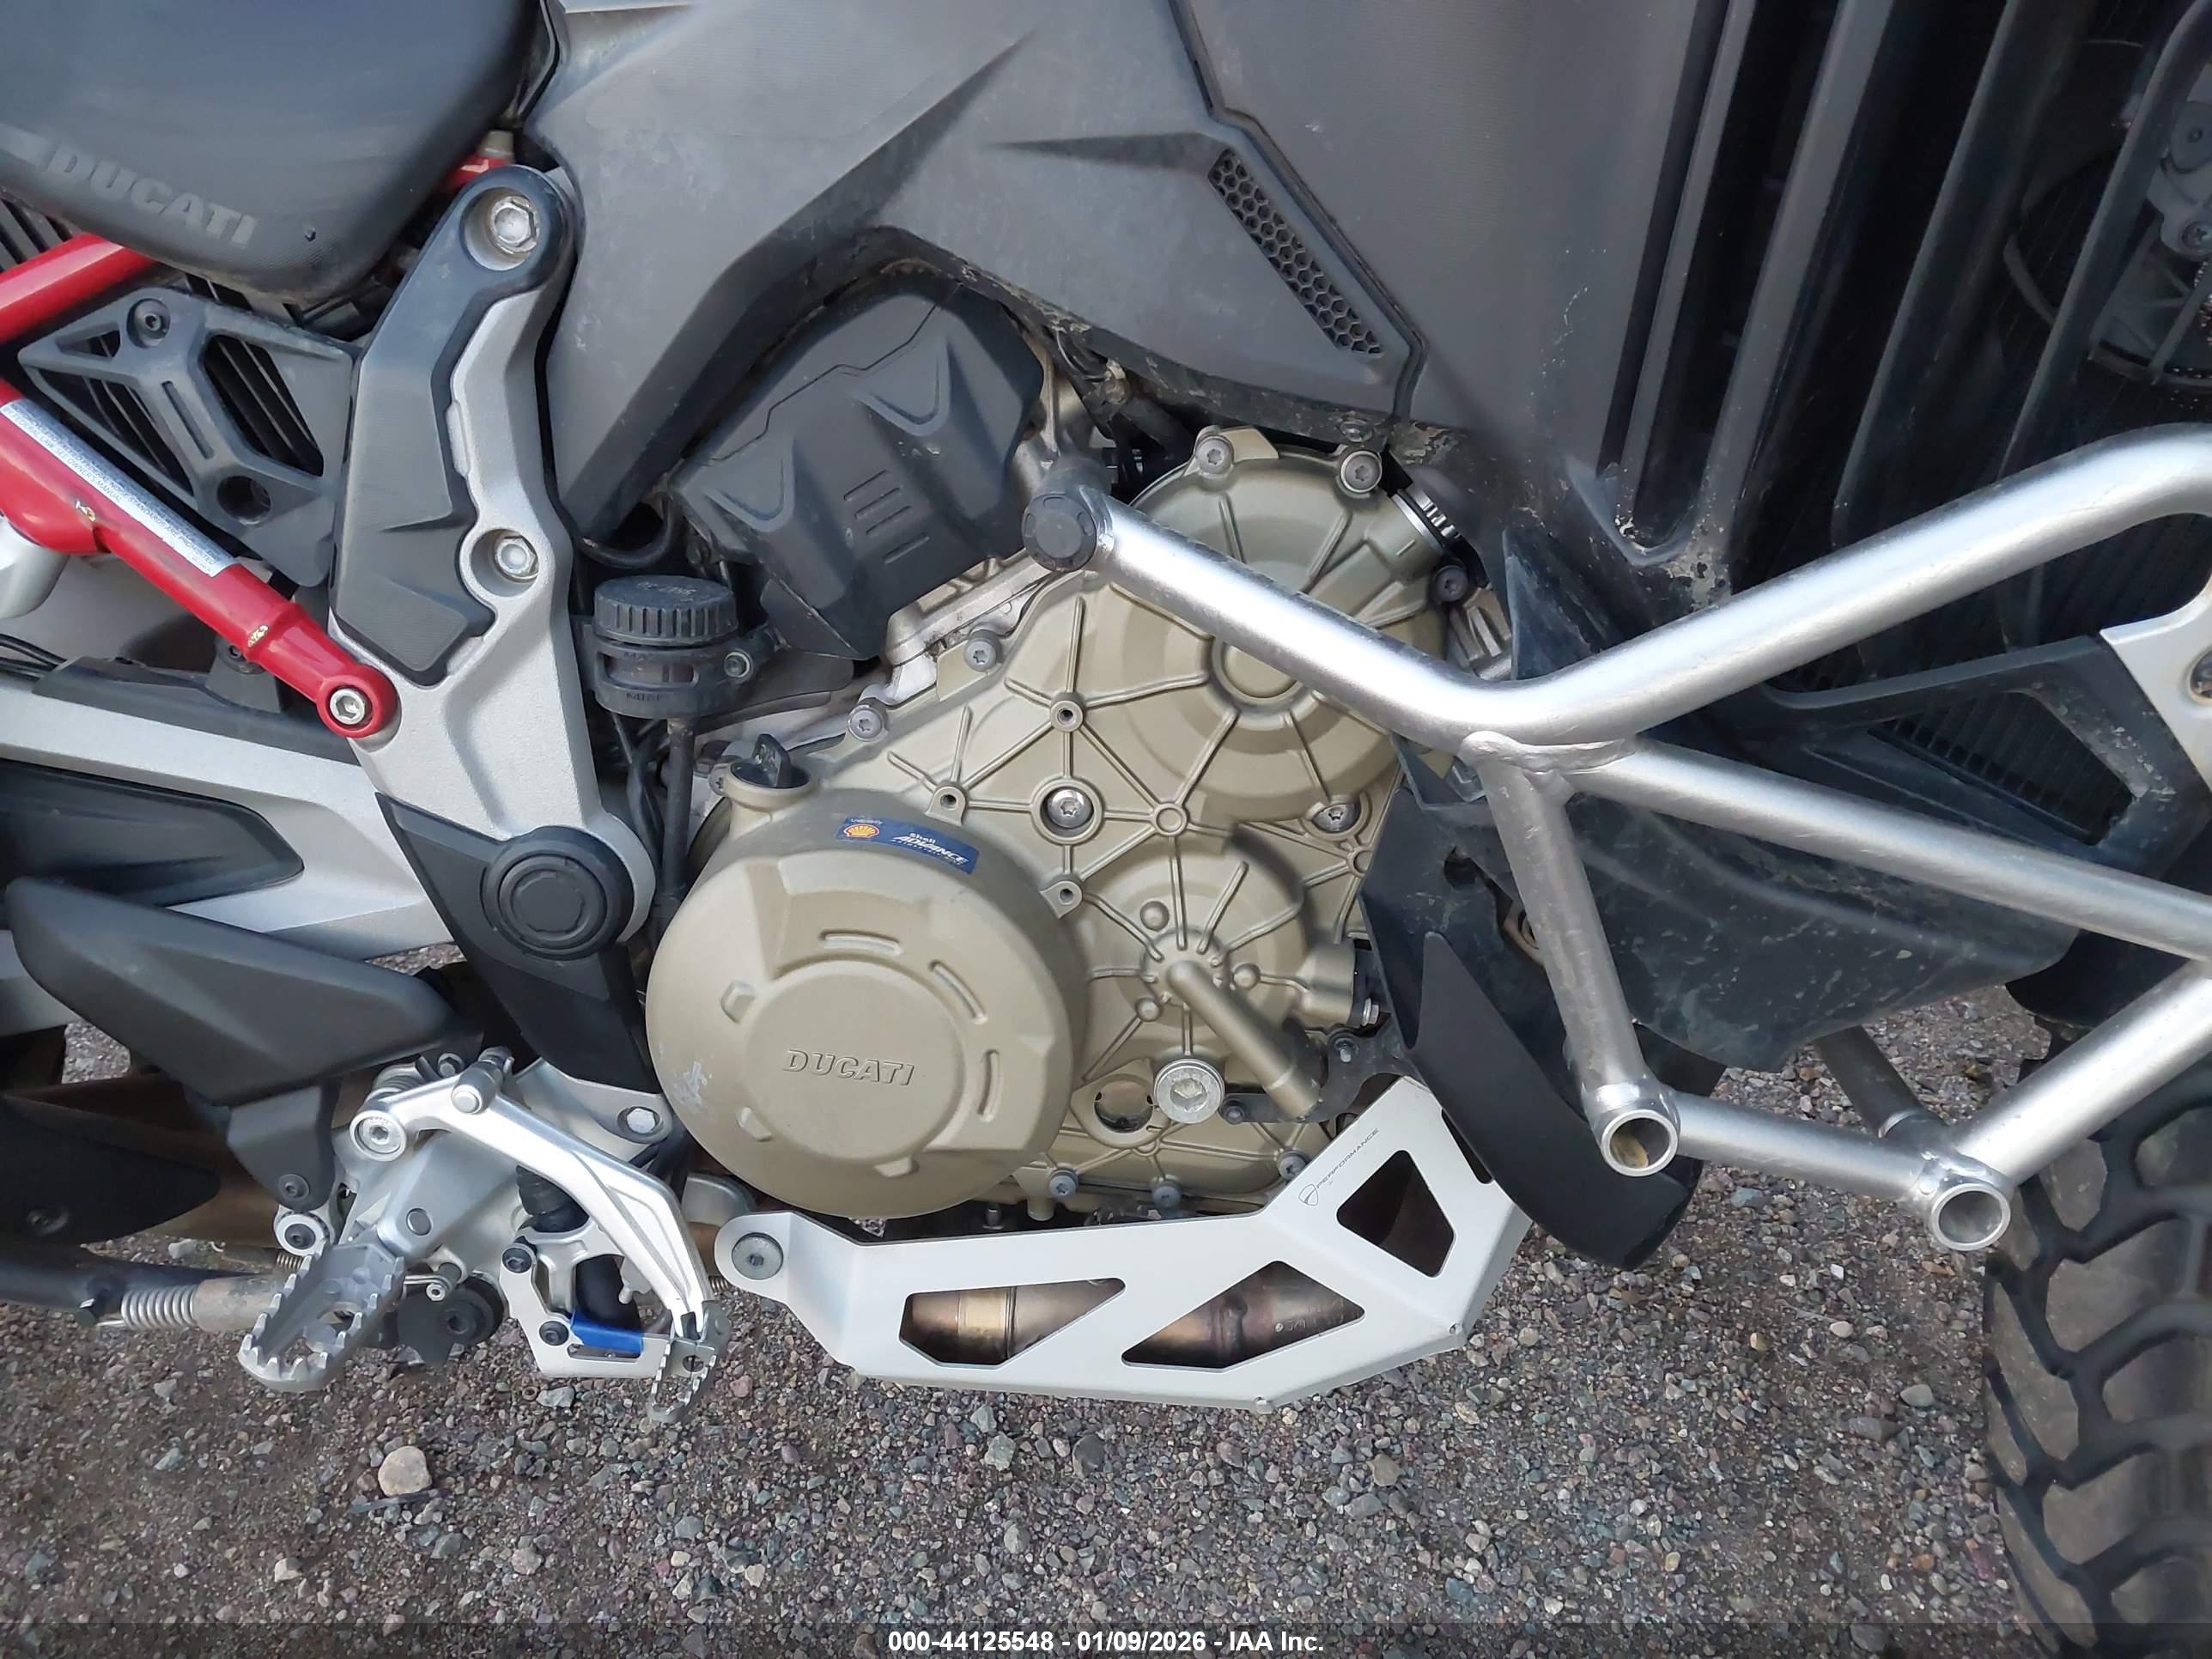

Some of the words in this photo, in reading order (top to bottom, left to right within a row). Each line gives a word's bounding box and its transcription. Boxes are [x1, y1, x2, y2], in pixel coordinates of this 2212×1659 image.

[46, 143, 257, 248] DUCATI
[95, 479, 124, 503] MANUAL
[81, 459, 110, 483] FEDERAL
[109, 481, 129, 498] NOISE
[127, 495, 167, 528] STANDARDS
[164, 524, 179, 538] ARE
[177, 534, 216, 566] PROHIBITED
[893, 836, 969, 863] ADVANCE
[909, 832, 936, 844] Shell
[782, 1049, 915, 1086] DUCATI
[1316, 1128, 1379, 1189] PERFORMANCE
